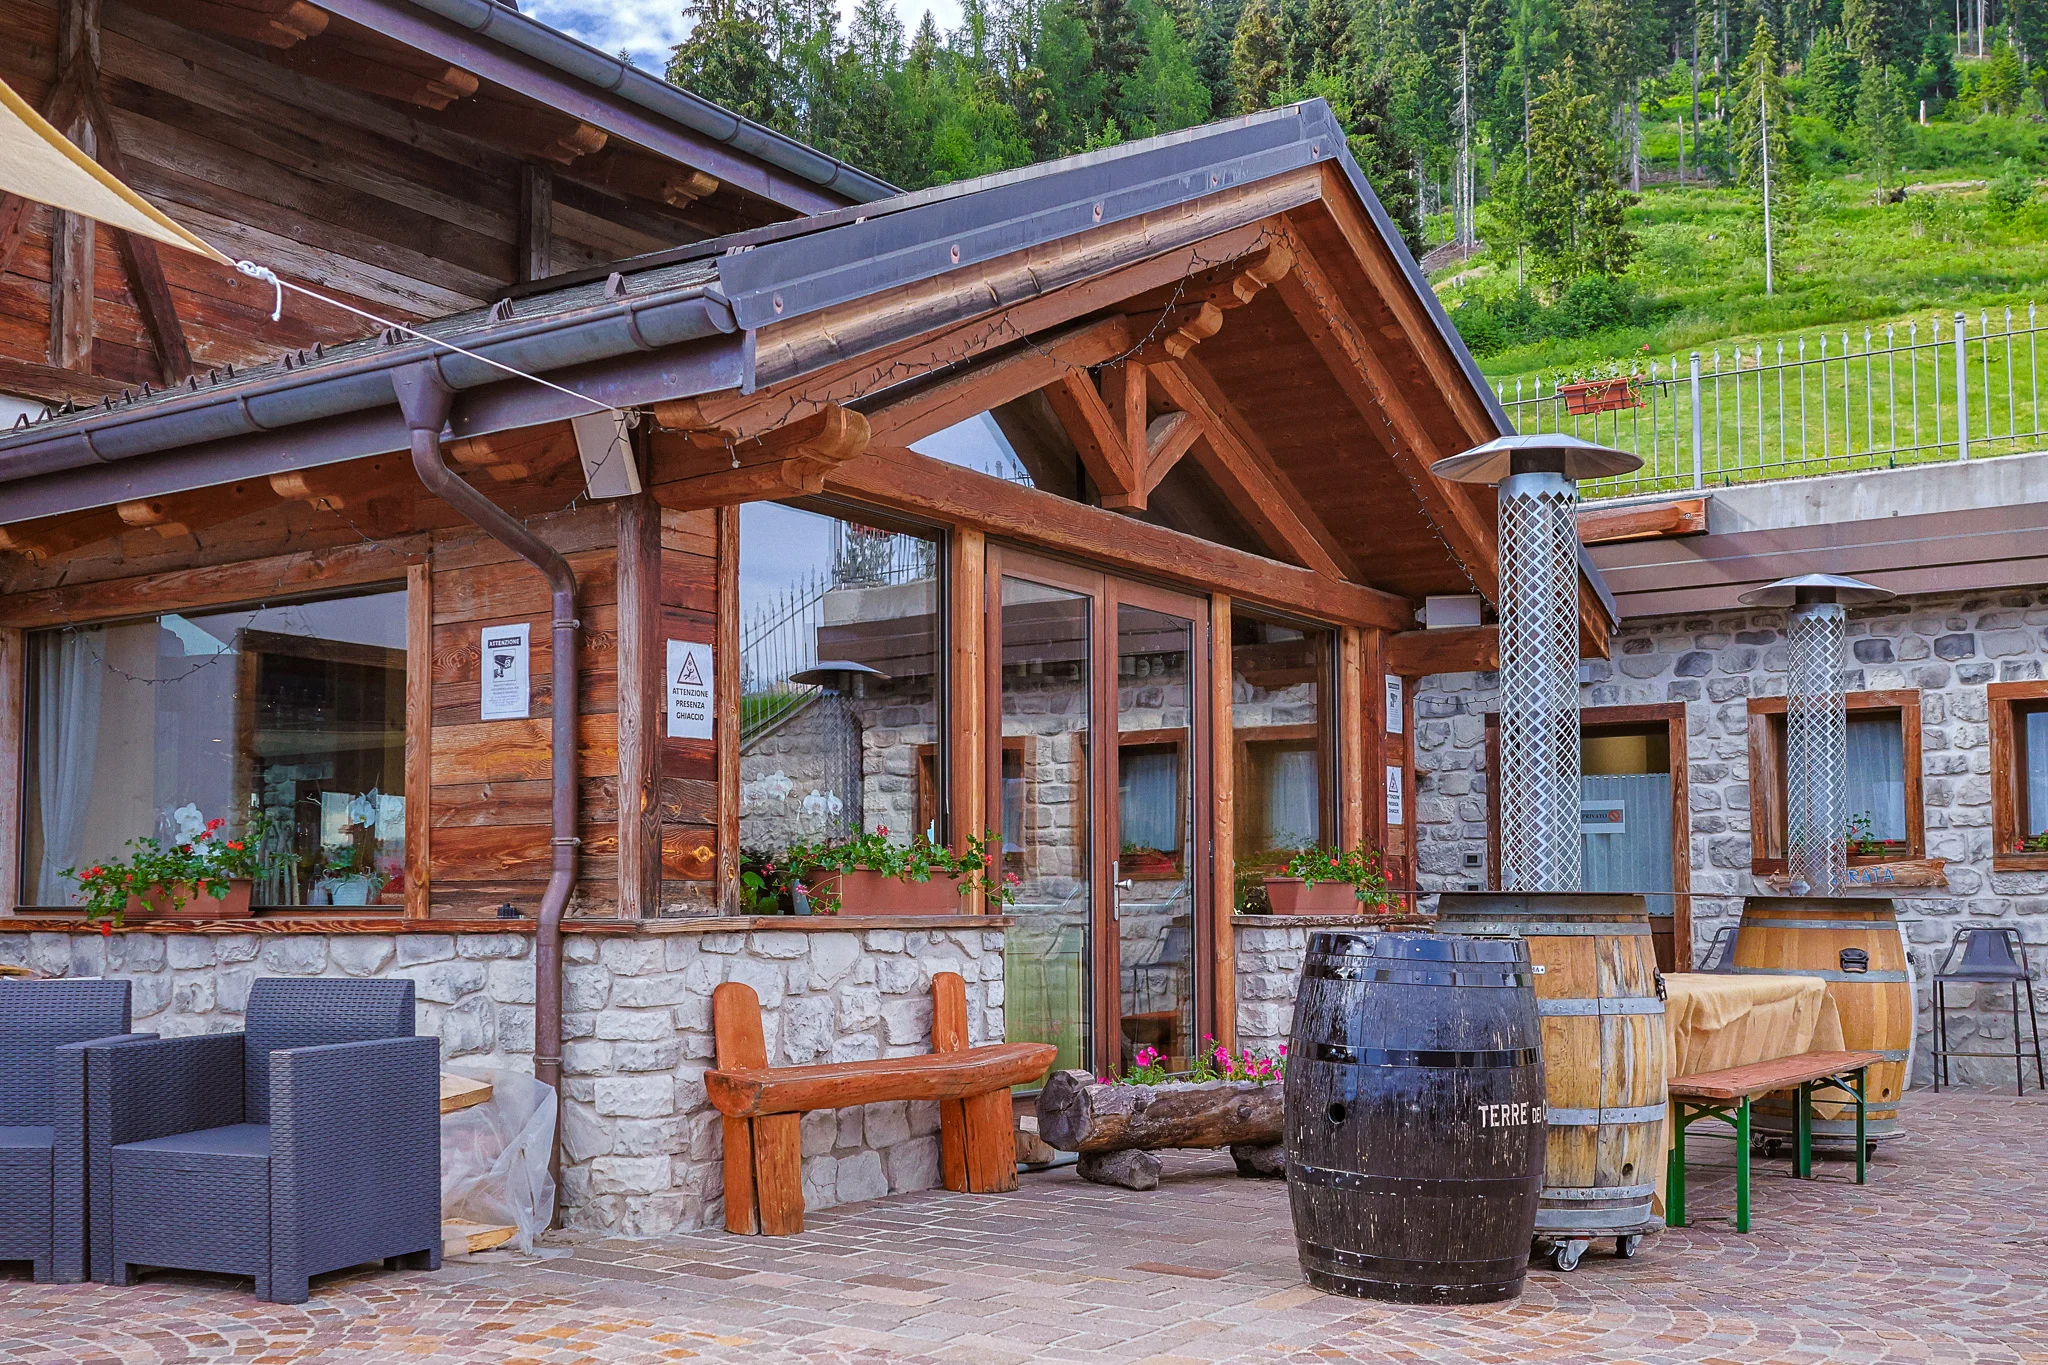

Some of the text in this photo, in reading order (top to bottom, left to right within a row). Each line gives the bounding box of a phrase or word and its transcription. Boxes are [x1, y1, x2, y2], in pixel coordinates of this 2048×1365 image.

[488, 638, 520, 647] ATTENZIONE
[672, 687, 709, 698] ATTENZIONE
[675, 699, 705, 709] PRESENZA
[676, 711, 705, 721] GHIACCIO
[1478, 1102, 1529, 1128] TERRE
